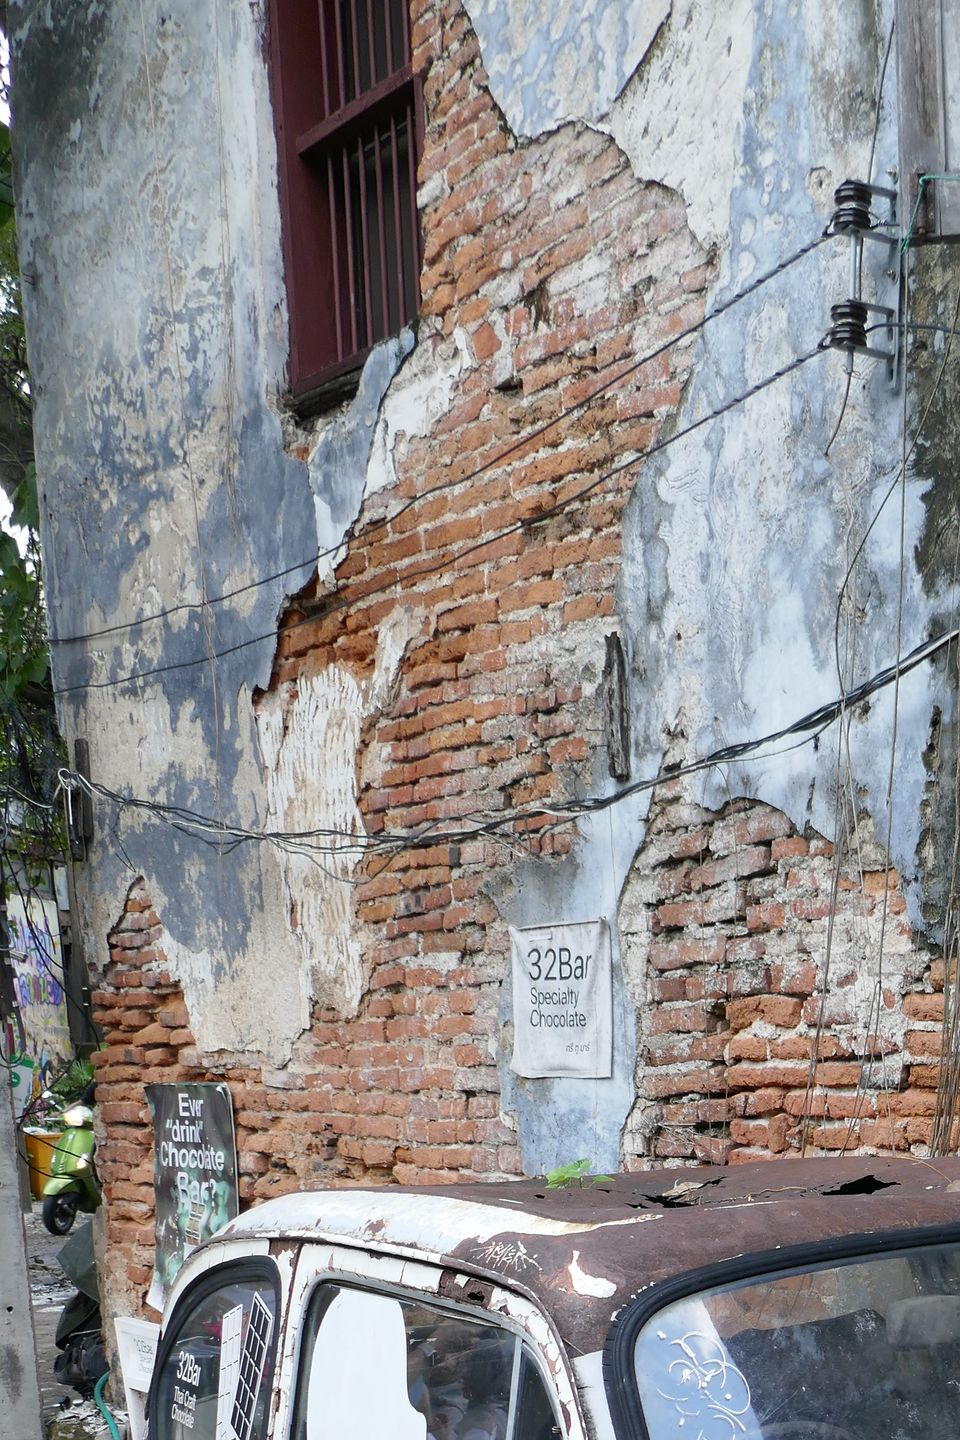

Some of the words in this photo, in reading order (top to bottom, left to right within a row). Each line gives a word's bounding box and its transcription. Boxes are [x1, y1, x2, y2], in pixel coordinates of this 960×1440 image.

[527, 947, 592, 981] 32Bar
[530, 987, 579, 1009] Specialty
[530, 1009, 587, 1028] Chocolate
[160, 1141, 225, 1170] Chocolate
[177, 1172, 217, 1207] Bar?
[177, 1351, 201, 1386] 32Bar
[174, 1386, 185, 1405] Thai
[171, 1403, 195, 1429] Chocolate
